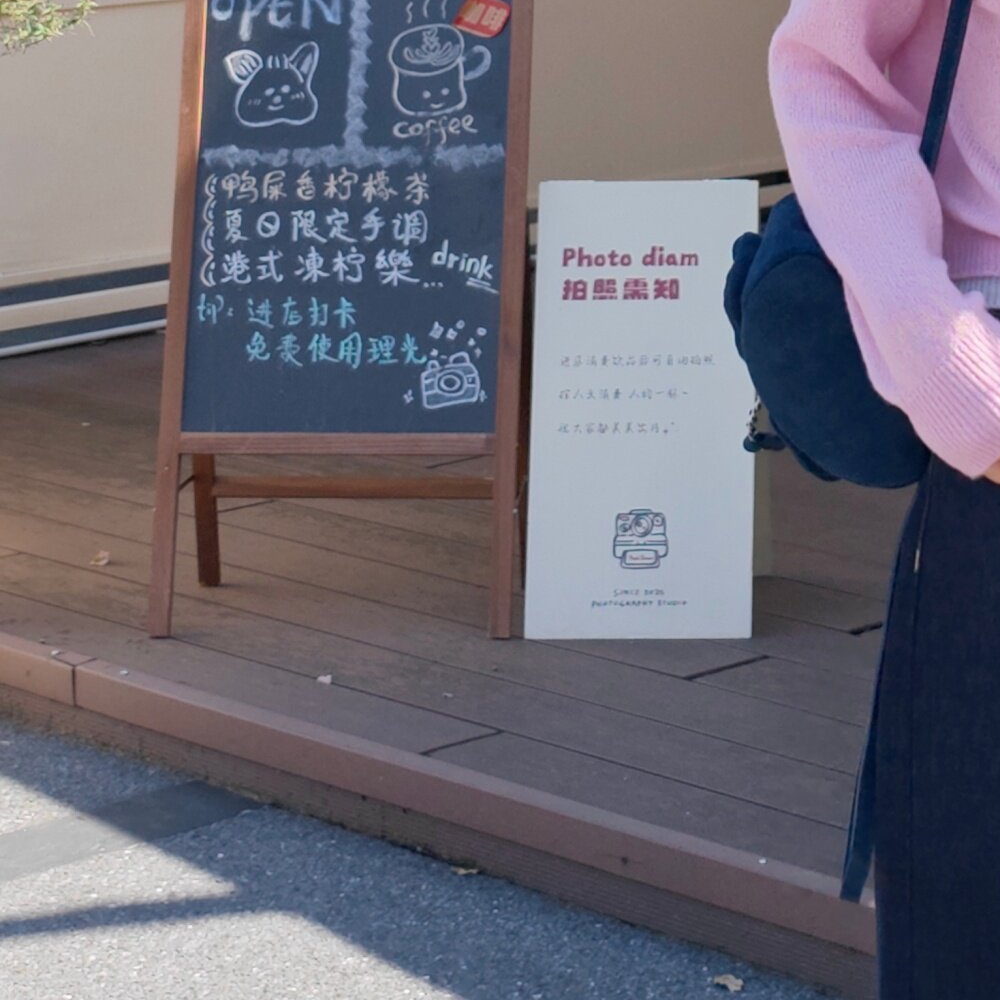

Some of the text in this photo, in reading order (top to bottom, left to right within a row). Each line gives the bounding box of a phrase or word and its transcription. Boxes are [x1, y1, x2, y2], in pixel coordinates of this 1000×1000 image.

[392, 114, 478, 145] coffee
[221, 167, 430, 205] 鸭屎香柠檬茶
[224, 206, 429, 245] 夏日限定手调
[431, 239, 494, 281] drink
[562, 246, 699, 267] Photo diam
[562, 278, 680, 300] 拍照需知
[247, 296, 358, 329] 进店打卡
[246, 331, 428, 369] 免费使用理光
